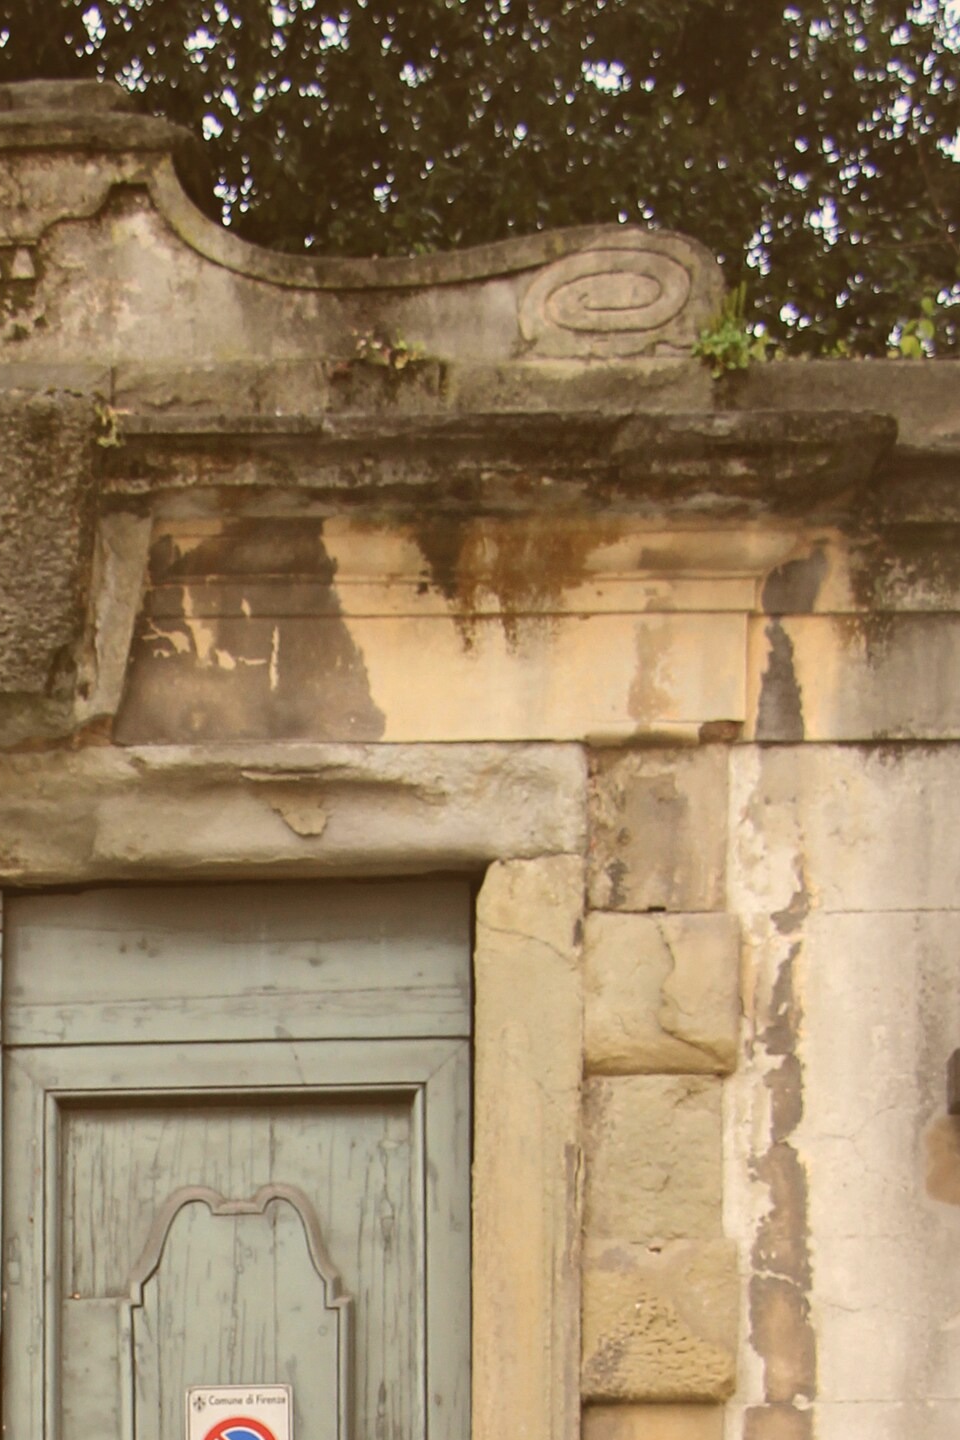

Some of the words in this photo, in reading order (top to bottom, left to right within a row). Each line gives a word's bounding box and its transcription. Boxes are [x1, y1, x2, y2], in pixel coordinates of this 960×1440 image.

[208, 1395, 243, 1405] Comune
[245, 1394, 254, 1405] di
[256, 1394, 286, 1405] Firenze
